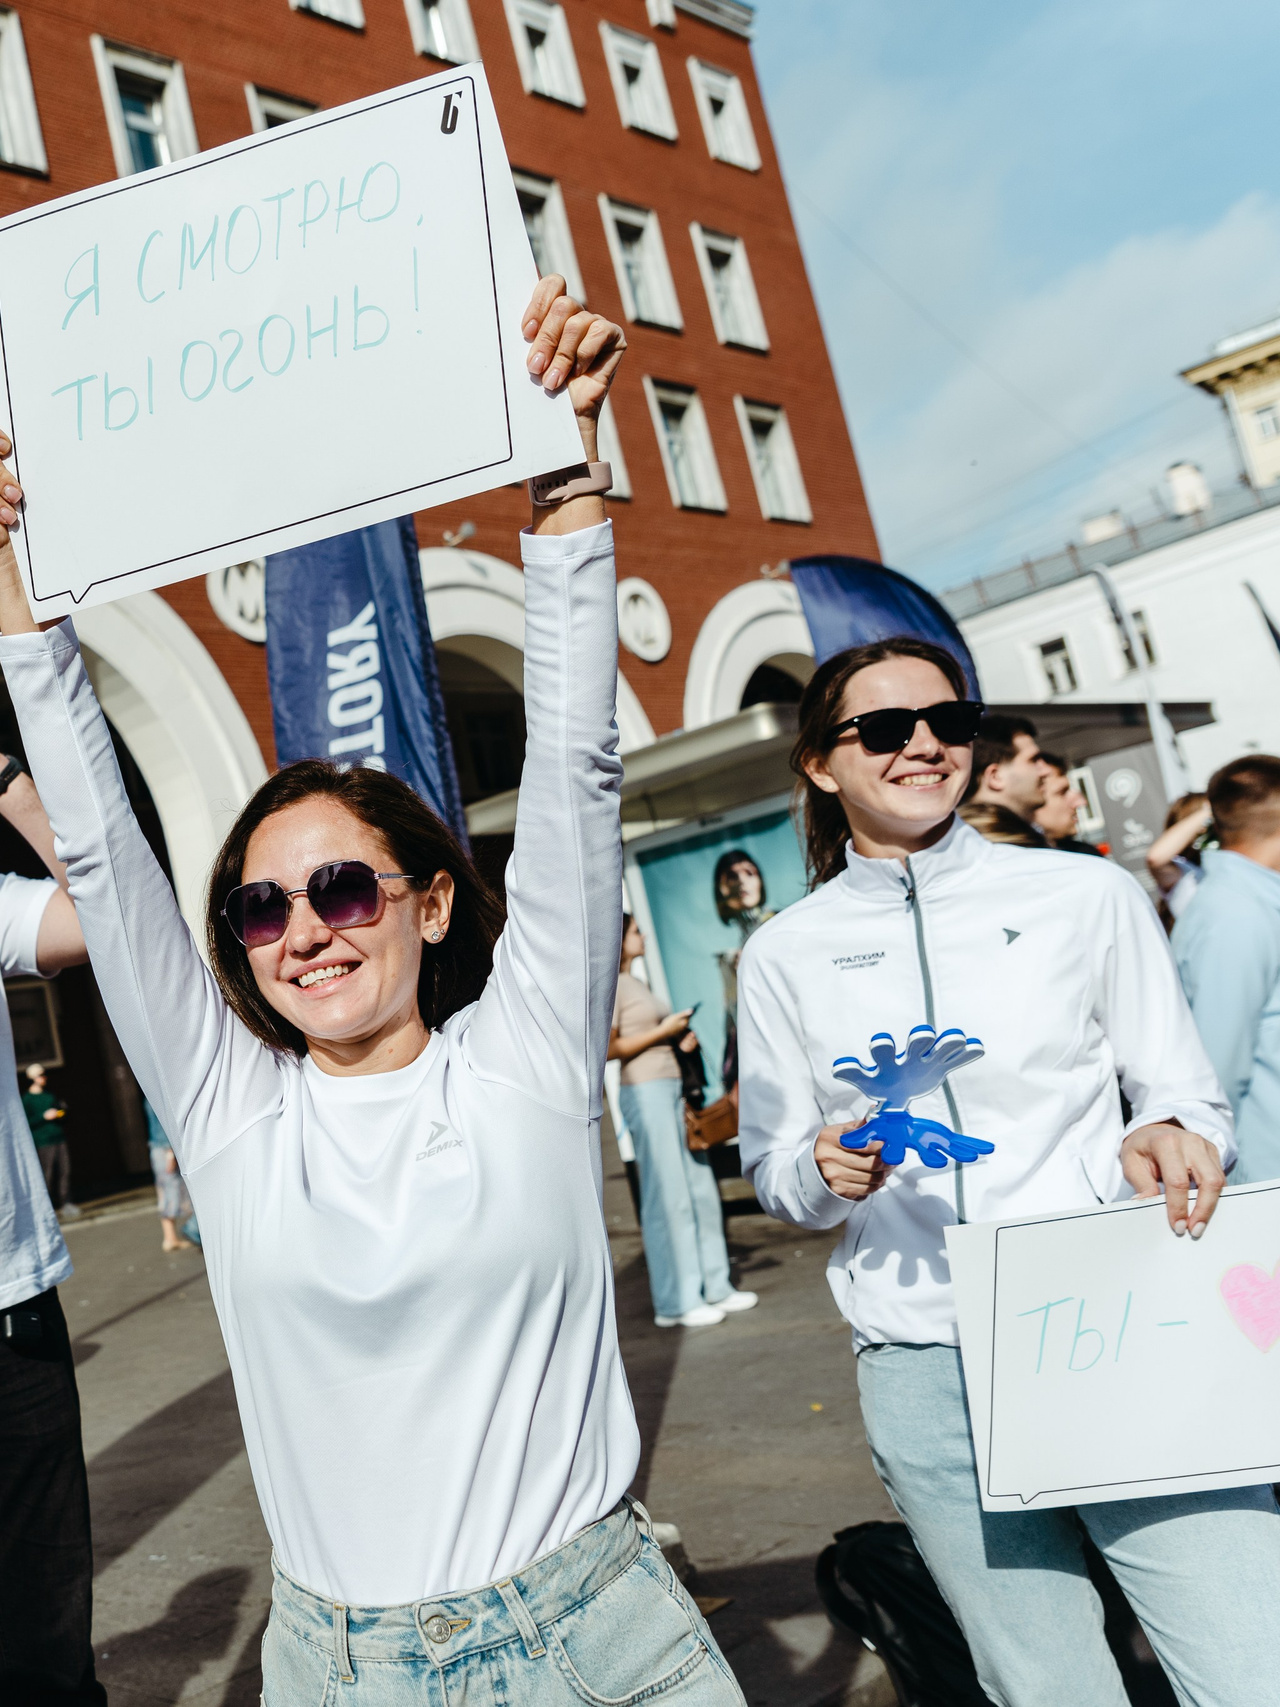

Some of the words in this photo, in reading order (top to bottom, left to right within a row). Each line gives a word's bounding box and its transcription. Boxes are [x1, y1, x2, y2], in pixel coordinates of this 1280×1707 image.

[61, 243, 100, 330] Я
[50, 355, 154, 441] ТЫ
[326, 600, 387, 774] TORY
[415, 1139, 464, 1162] DEMIX
[1016, 1290, 1132, 1374] ТЫ
